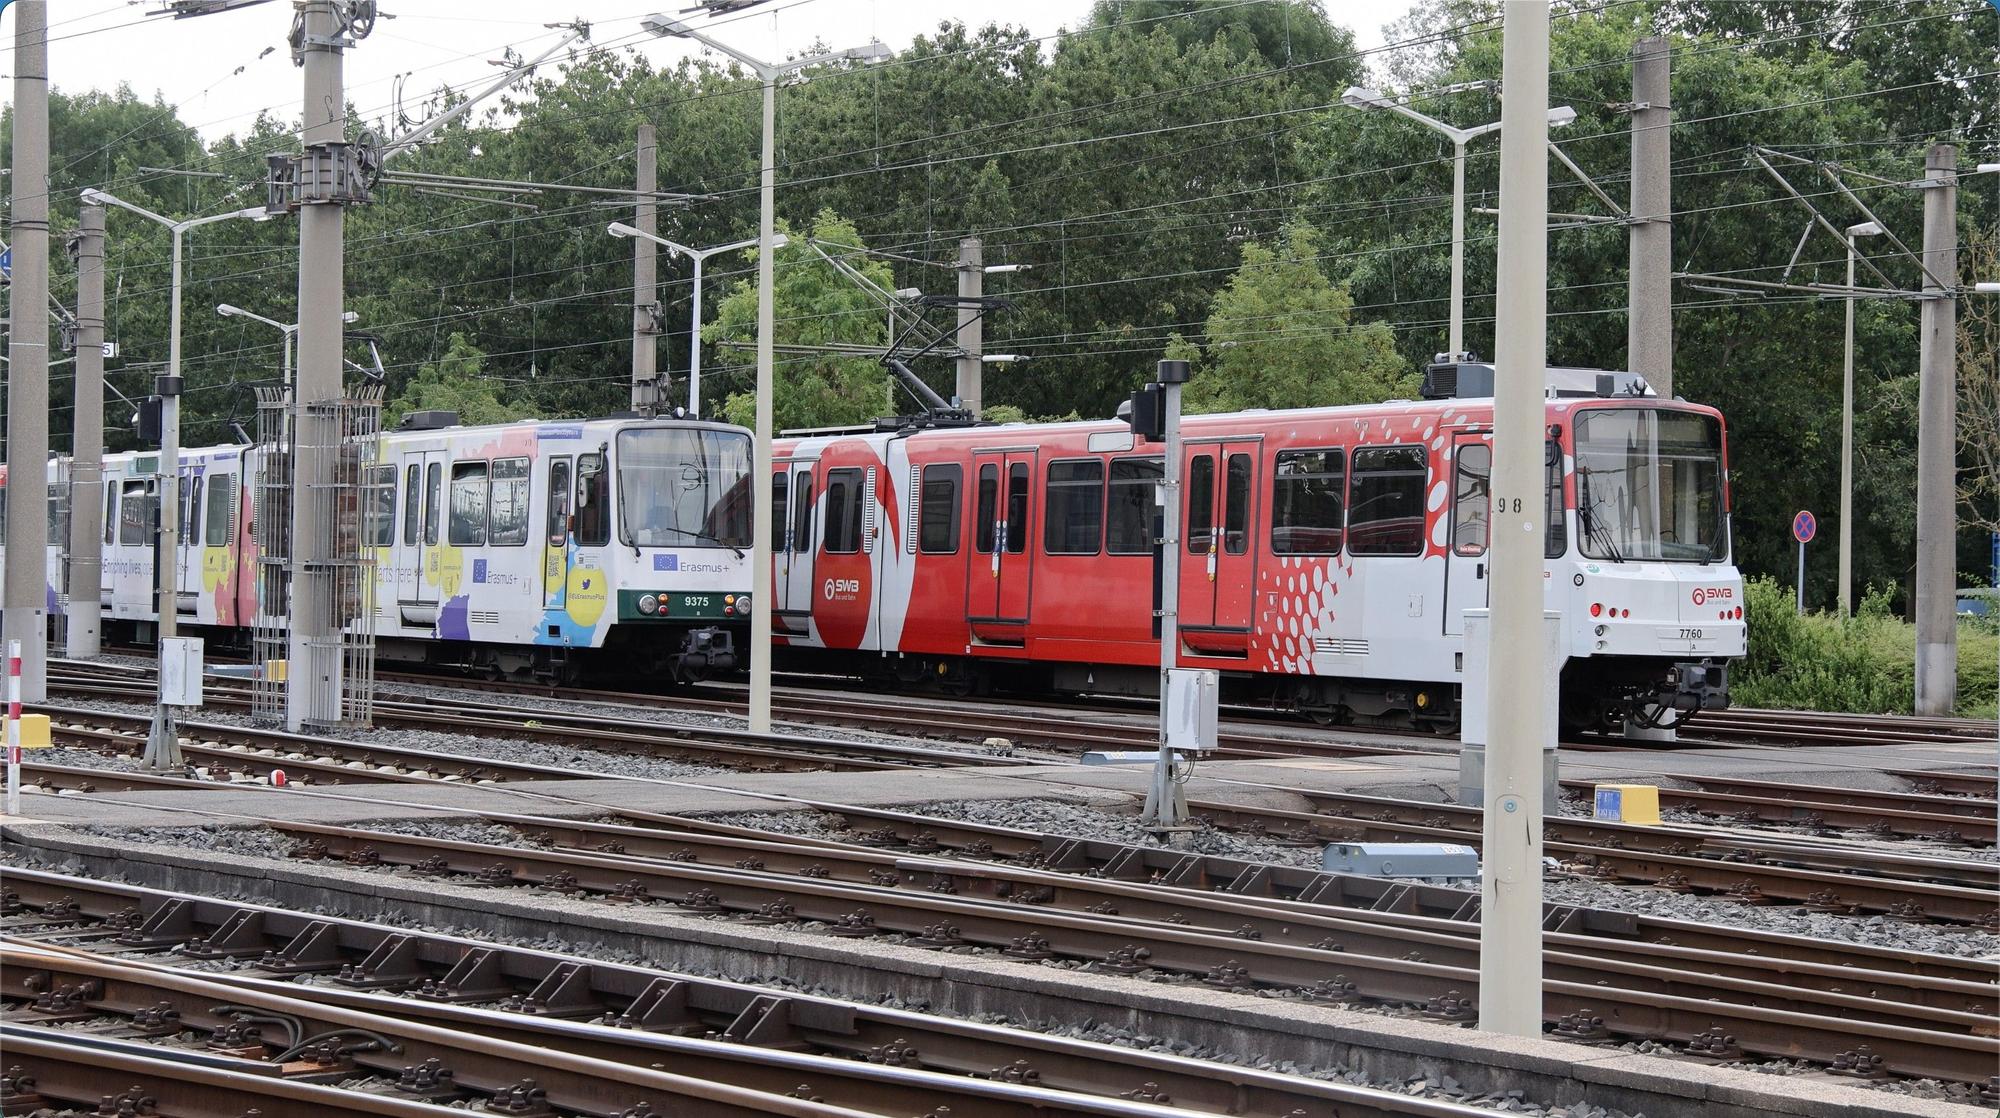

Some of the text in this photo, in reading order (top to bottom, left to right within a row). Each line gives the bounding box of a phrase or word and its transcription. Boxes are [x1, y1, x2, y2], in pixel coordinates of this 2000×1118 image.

[680, 561, 730, 573] Erasmus+
[486, 570, 519, 585] Erasmus+
[836, 580, 859, 592] SWB
[1706, 588, 1732, 598] SWB
[684, 596, 709, 607] 9375
[1679, 628, 1703, 639] 7760
